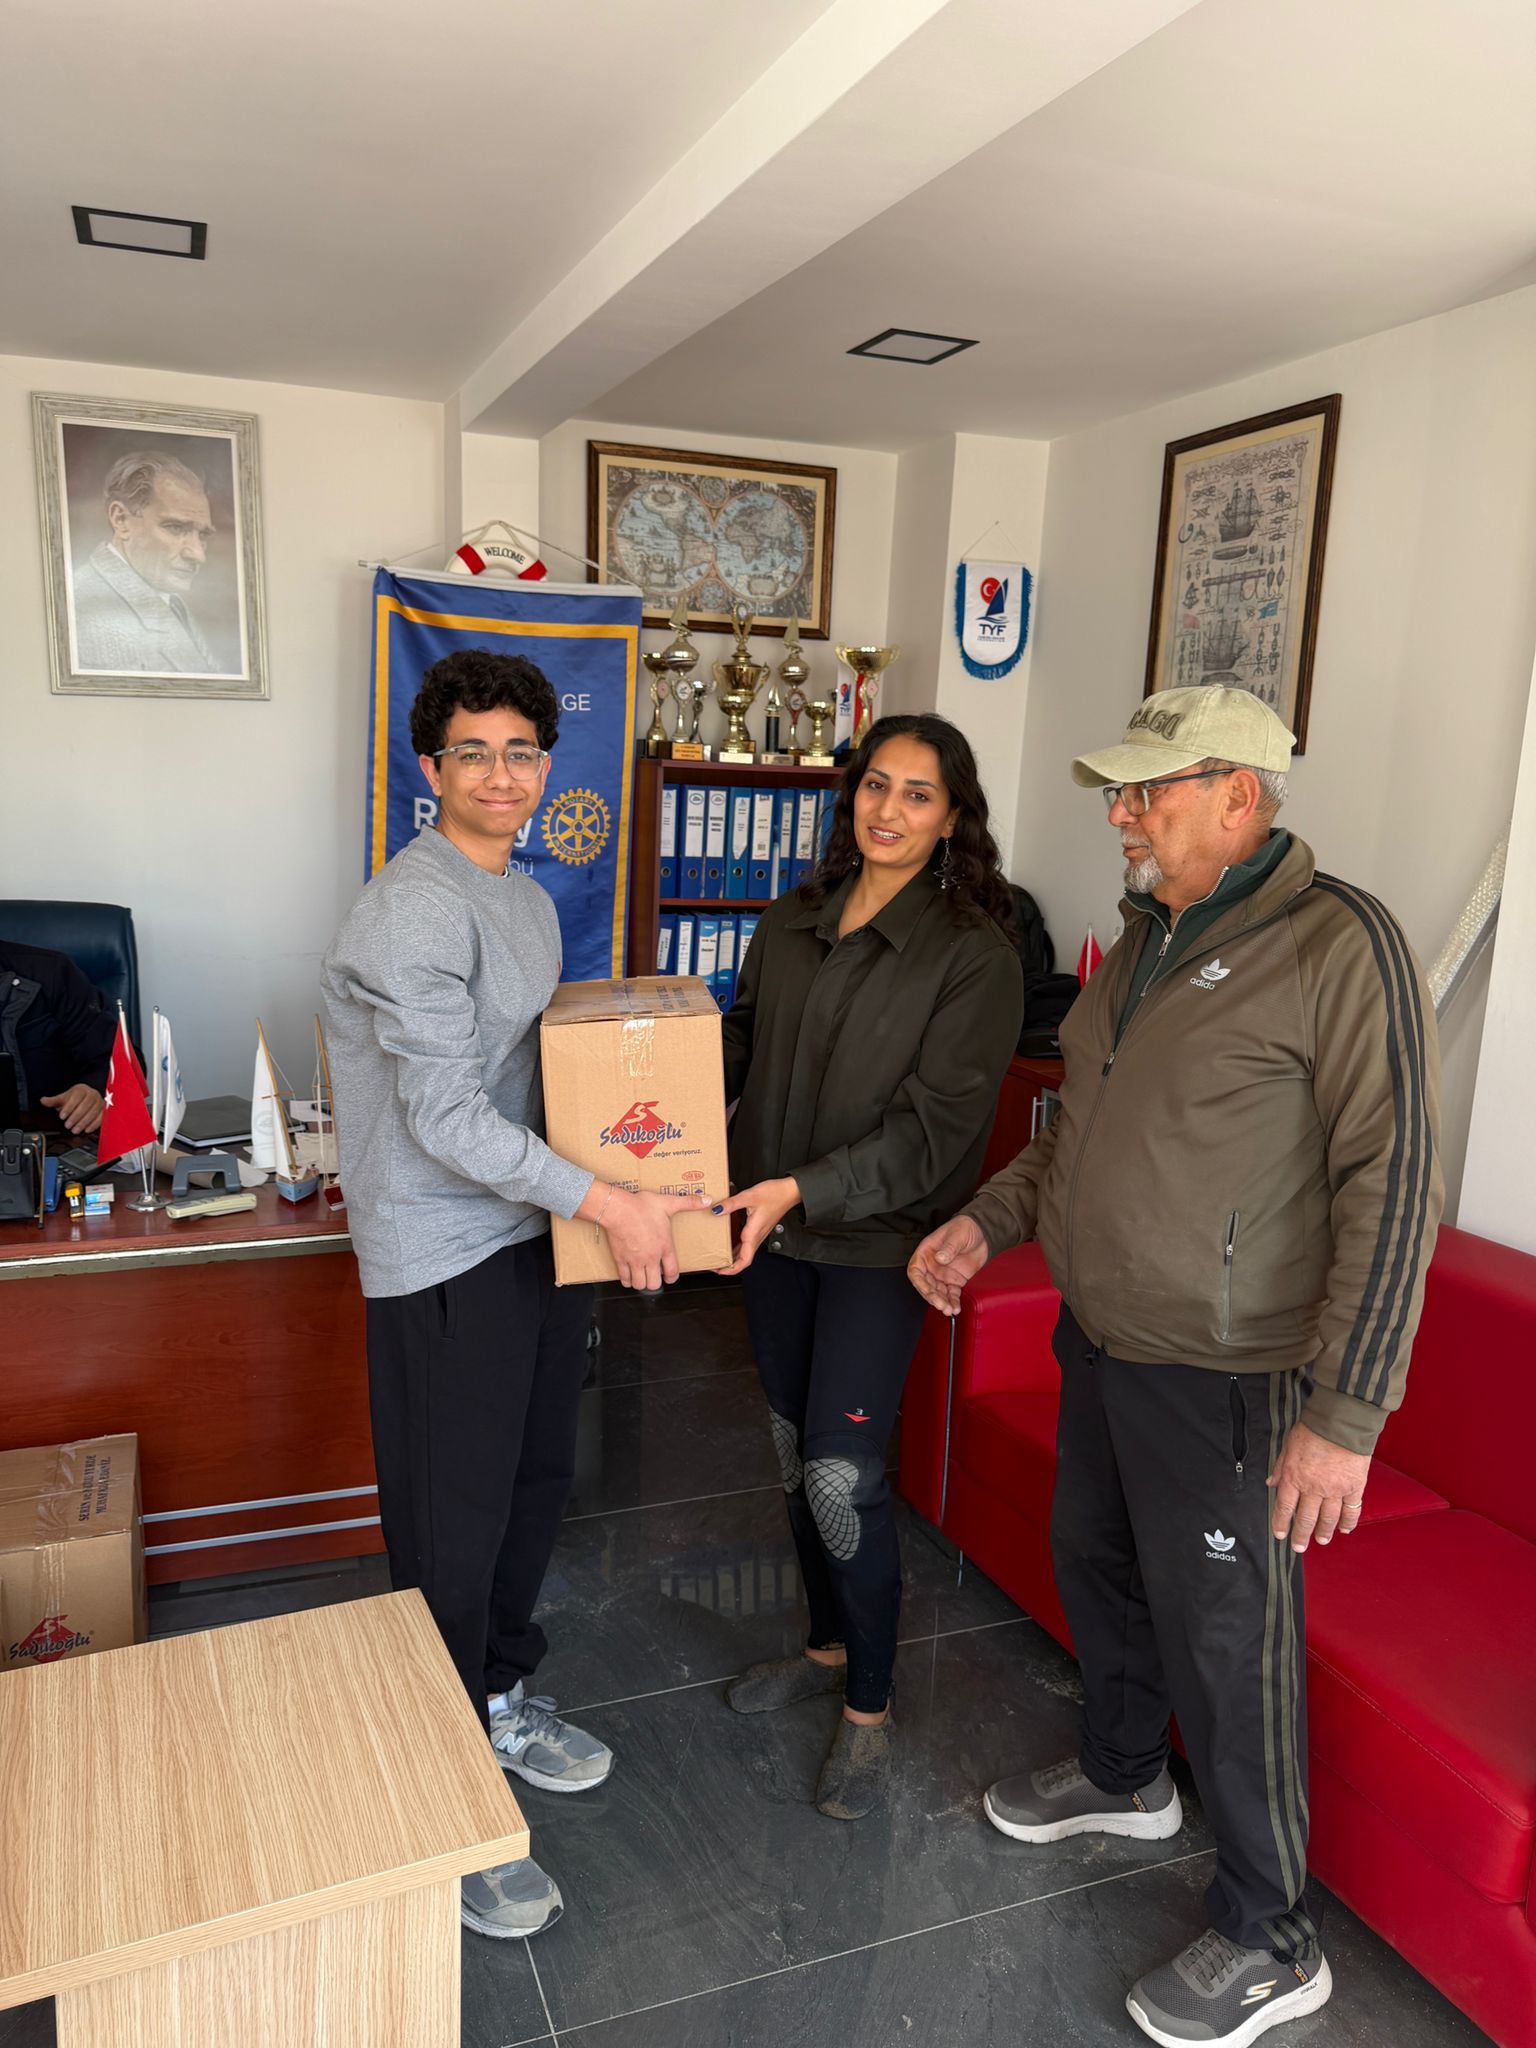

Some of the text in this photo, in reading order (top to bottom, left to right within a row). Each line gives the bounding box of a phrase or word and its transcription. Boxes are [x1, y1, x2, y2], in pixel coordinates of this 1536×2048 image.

[484, 547, 526, 565] WELCOME
[979, 624, 1007, 636] TYF
[558, 693, 592, 712] GE
[599, 1122, 683, 1148] Sadıkoğlu
[1205, 1551, 1237, 1562] adidas
